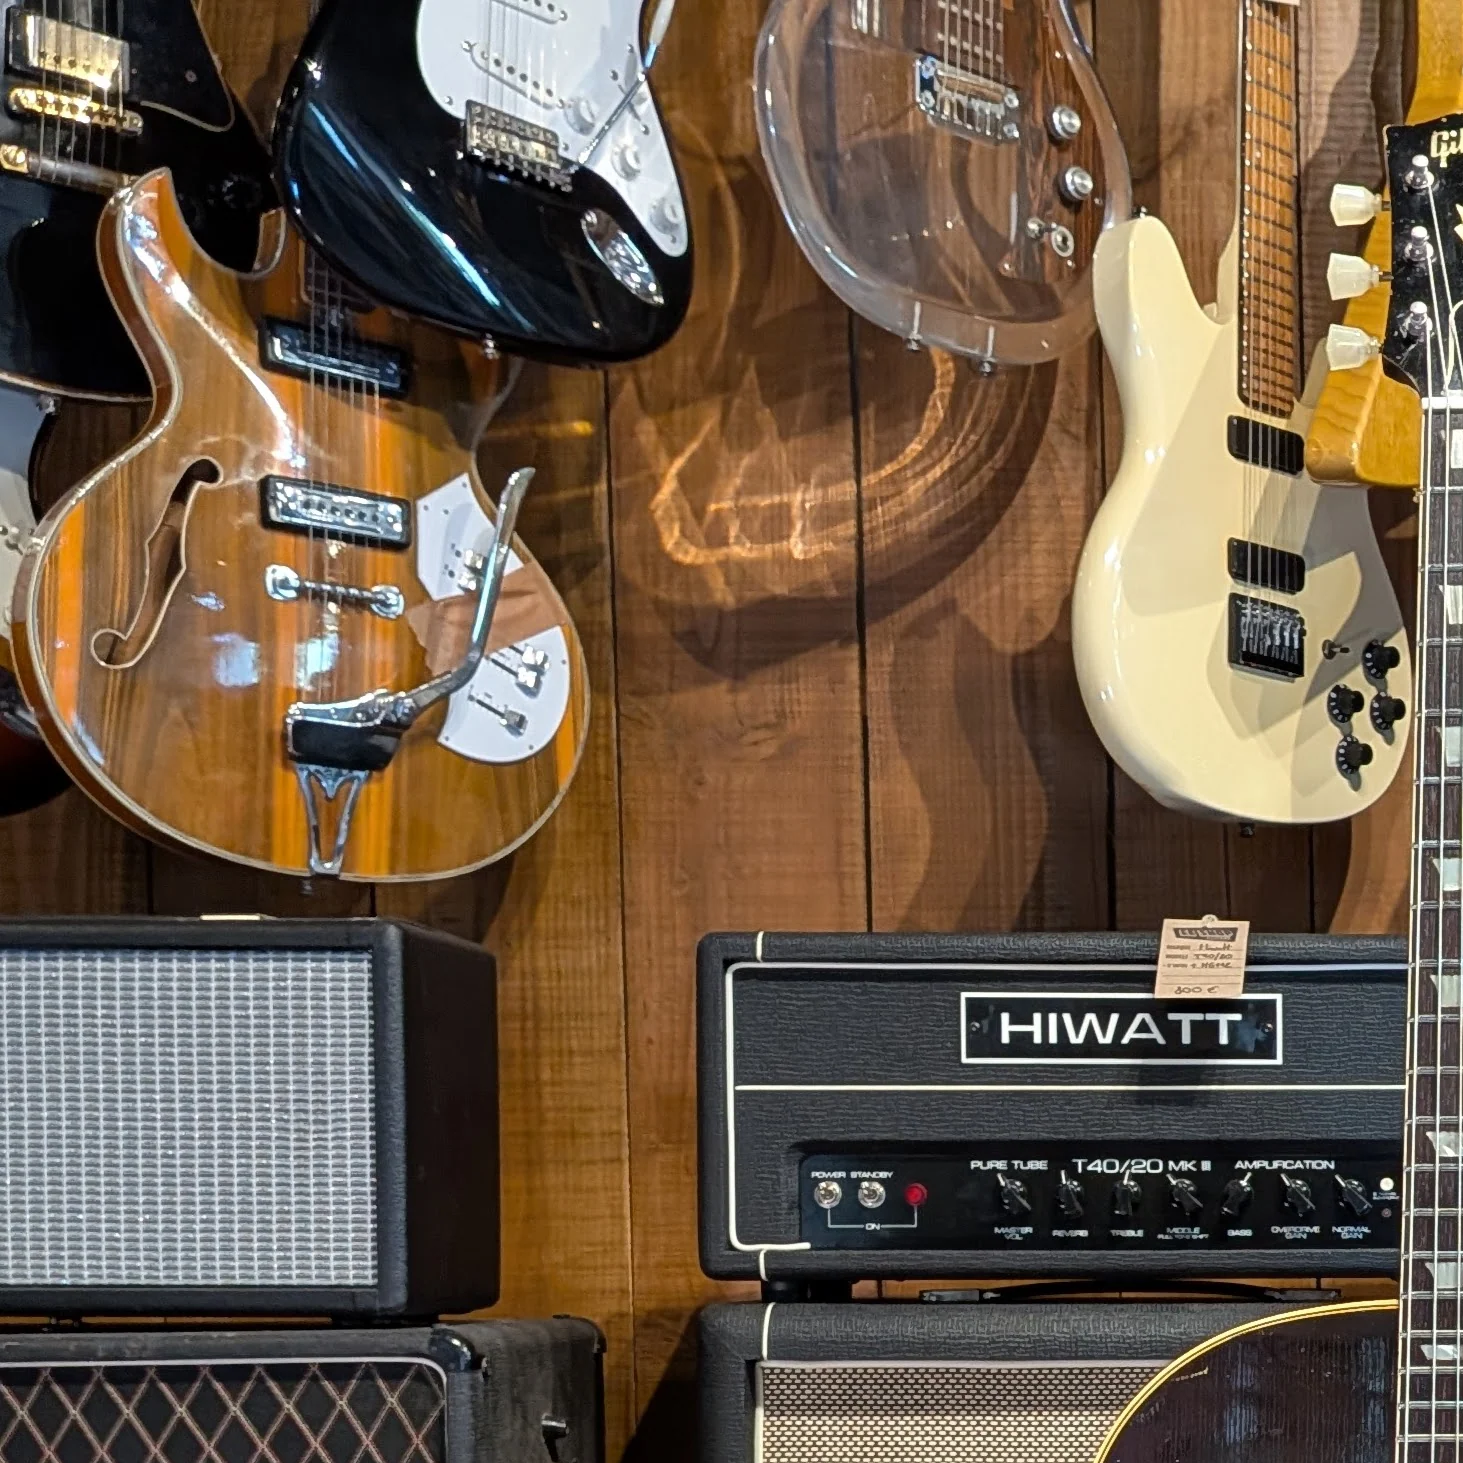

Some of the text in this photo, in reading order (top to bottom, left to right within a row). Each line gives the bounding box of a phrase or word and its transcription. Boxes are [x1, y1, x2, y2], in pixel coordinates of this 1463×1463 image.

[1000, 1012, 1243, 1046] HIWATT
[970, 1159, 1049, 1171] PURE TUBE
[1072, 1158, 1164, 1174] T40/20
[1168, 1160, 1197, 1172] MK
[1234, 1160, 1336, 1170] AMPLIFICATION
[811, 1171, 893, 1179] POWER STANDBY
[865, 1223, 881, 1231] ON
[1332, 1226, 1371, 1234] NORMAL
[1227, 1229, 1253, 1237] BASS
